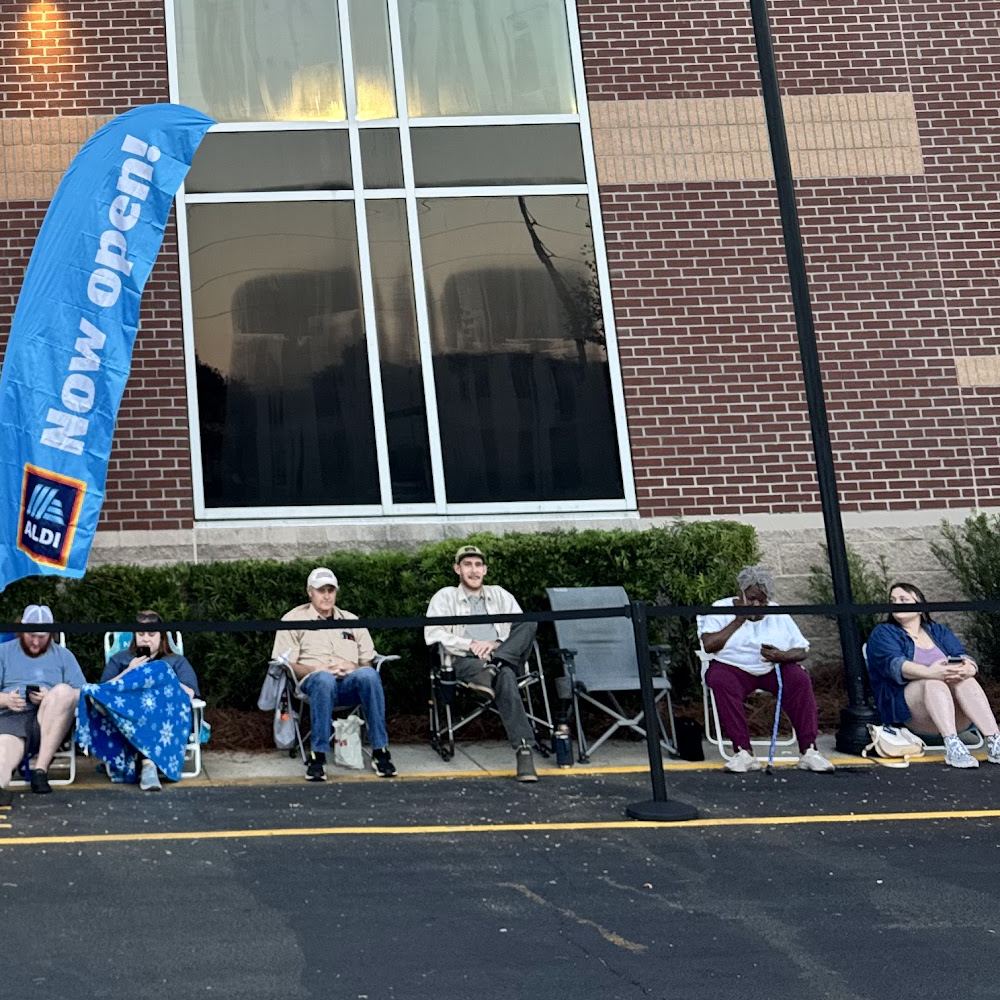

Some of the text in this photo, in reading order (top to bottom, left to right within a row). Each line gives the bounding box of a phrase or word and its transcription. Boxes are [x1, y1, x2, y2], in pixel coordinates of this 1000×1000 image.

[40, 133, 161, 456] Now open!
[24, 520, 62, 549] ALDI
